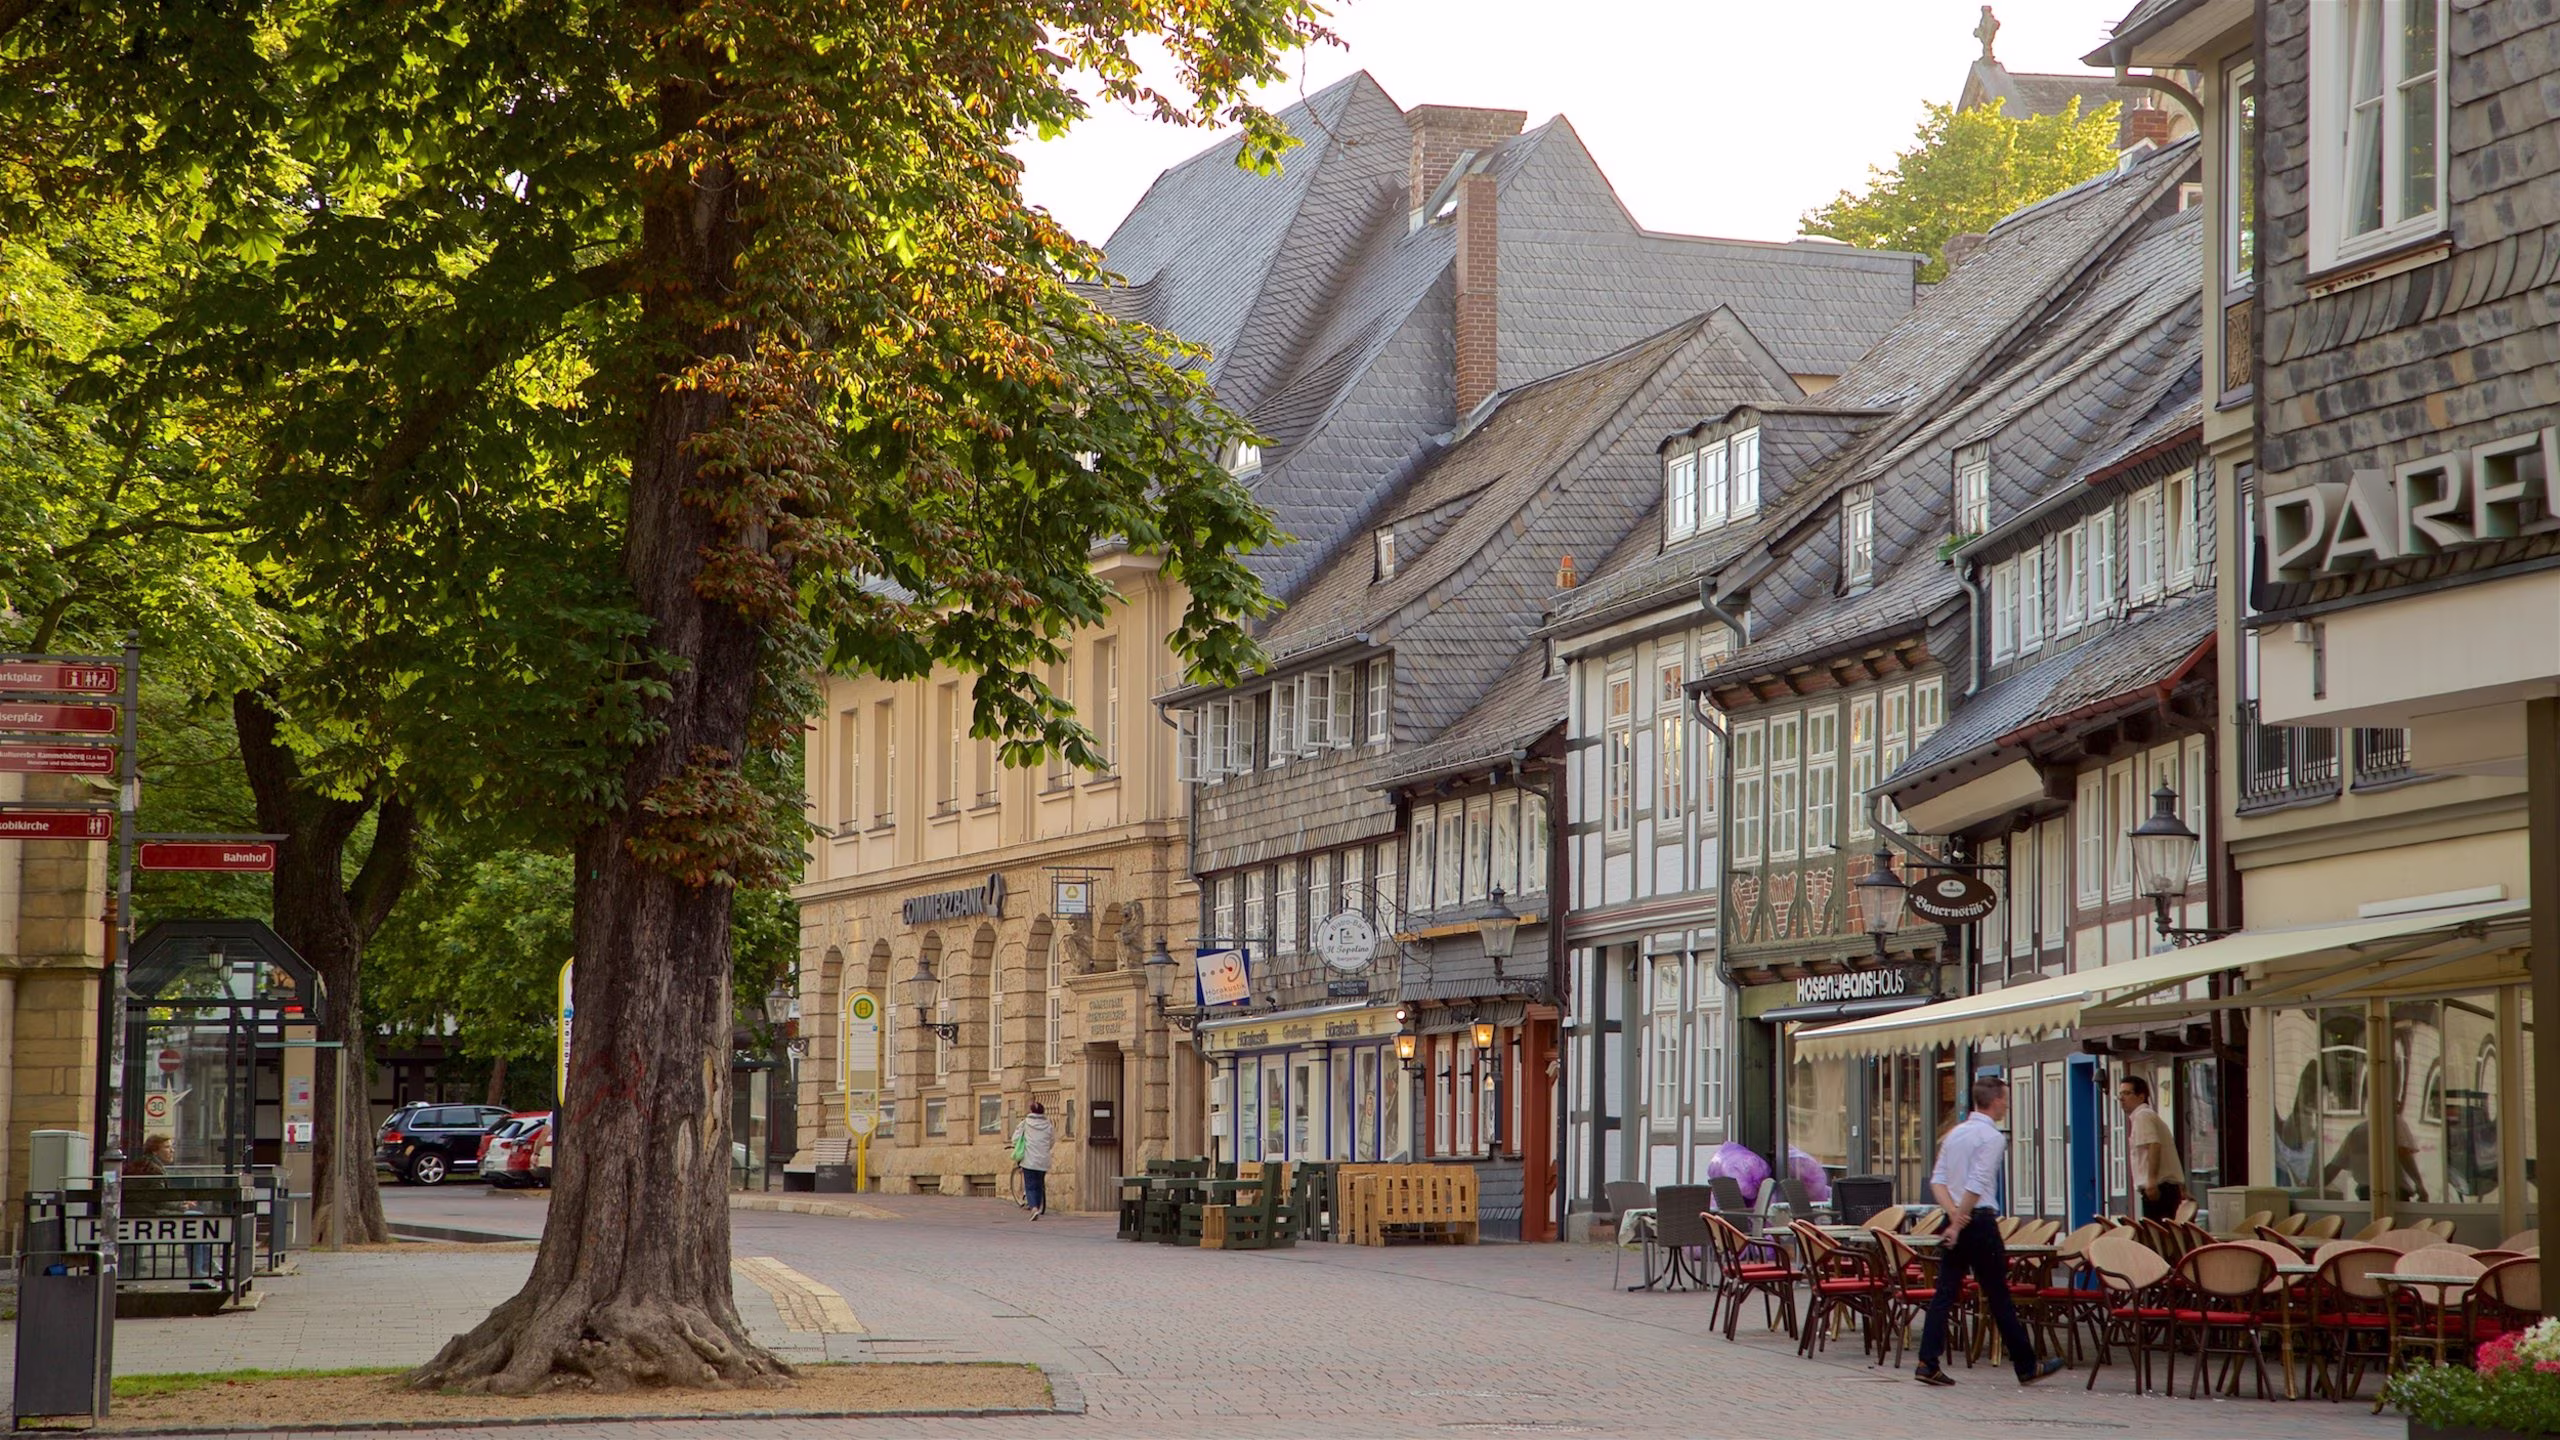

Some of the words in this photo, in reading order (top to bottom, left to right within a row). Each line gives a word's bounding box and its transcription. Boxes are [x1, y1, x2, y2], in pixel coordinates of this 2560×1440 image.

[223, 852, 267, 863] Bahnhof
[903, 886, 986, 926] COMMERZBANK
[151, 1101, 164, 1112] 30
[90, 1220, 220, 1240] HERREN
